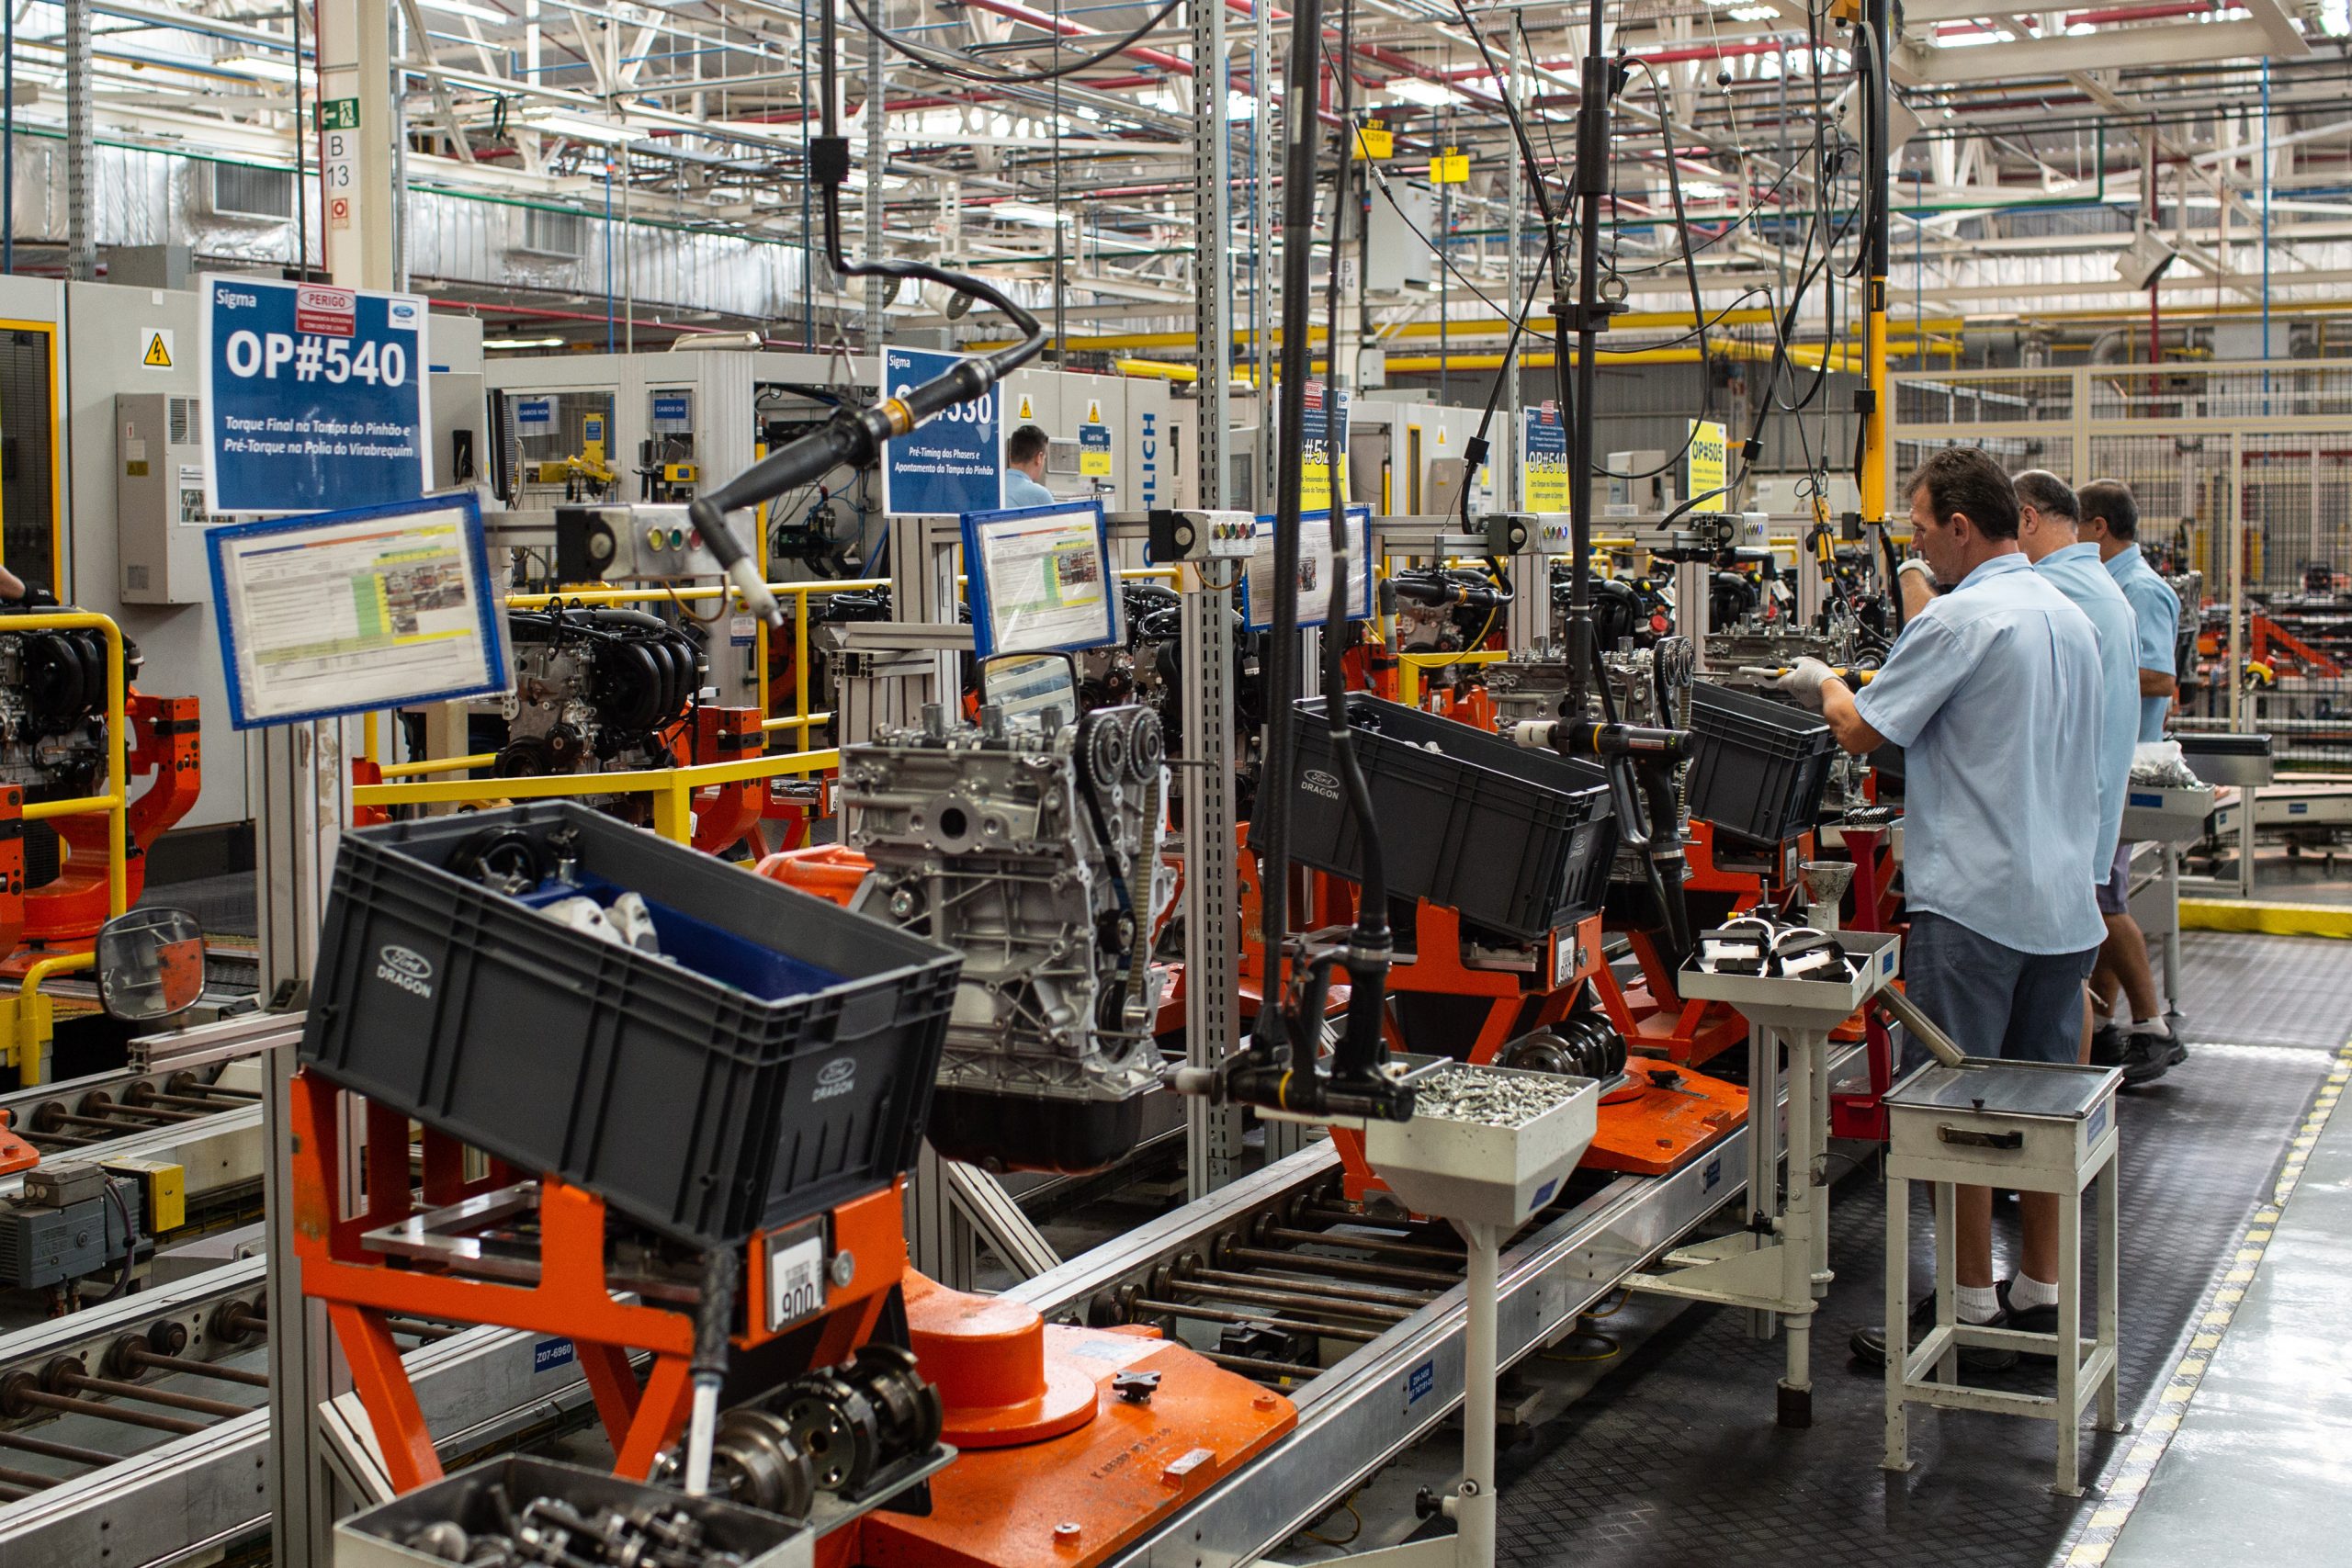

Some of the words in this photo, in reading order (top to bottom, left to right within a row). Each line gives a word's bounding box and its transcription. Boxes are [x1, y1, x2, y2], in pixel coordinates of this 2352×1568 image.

[331, 135, 345, 157] B
[326, 164, 349, 186] 13
[1341, 260, 1352, 274] B
[216, 288, 257, 310] Sigma
[309, 293, 345, 308] PERIGO
[226, 329, 406, 388] OP#540
[888, 355, 910, 369] Sigma
[895, 384, 992, 424] 530
[225, 415, 265, 434] Torque
[266, 417, 294, 433] Final
[295, 422, 310, 434] na
[312, 420, 348, 436] Tampa
[349, 421, 364, 434] do
[365, 422, 402, 436] Pinhão
[403, 426, 411, 436] e
[223, 438, 286, 456] Pré-Torque
[287, 442, 302, 455] na
[304, 440, 333, 456] Polia
[334, 442, 348, 456] do
[348, 443, 413, 459] Virabrequim
[909, 446, 941, 459] Pré-Timing
[942, 447, 952, 458] dos
[953, 448, 976, 459] Phasers
[1692, 440, 1723, 462] OP#505
[894, 461, 936, 475] Apontamento
[945, 463, 965, 476] Tampa
[974, 464, 994, 476] Pinhão
[1529, 451, 1567, 473] OP#510
[1301, 781, 1340, 800] DRAGON
[386, 949, 426, 976] Ford
[377, 964, 432, 998] DRAGON
[811, 1078, 855, 1102] DRAGON
[782, 1282, 814, 1319] 900
[537, 1343, 571, 1364] Z07-6960
